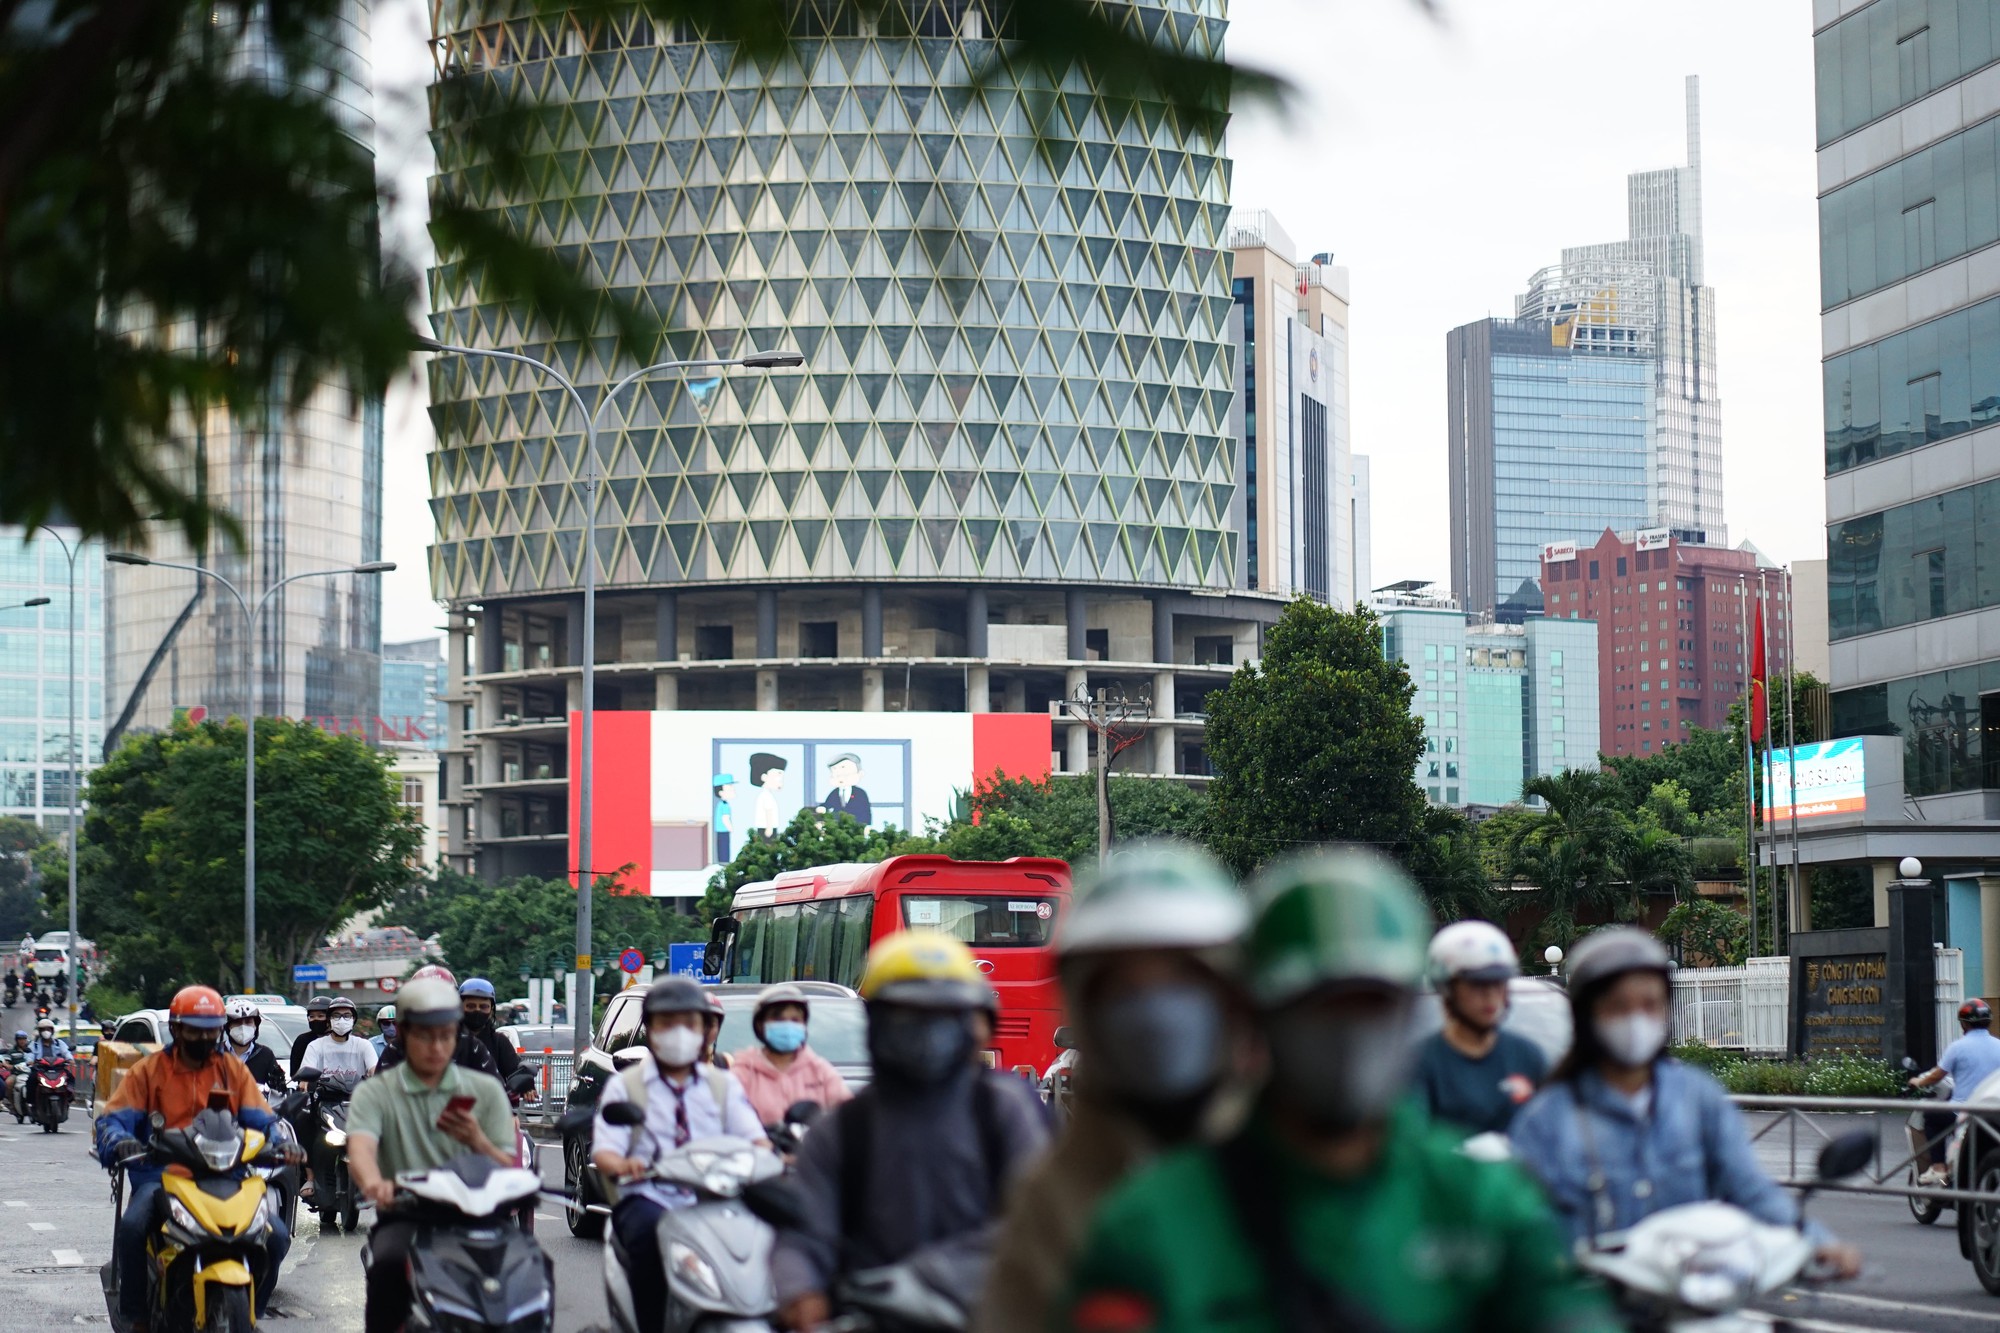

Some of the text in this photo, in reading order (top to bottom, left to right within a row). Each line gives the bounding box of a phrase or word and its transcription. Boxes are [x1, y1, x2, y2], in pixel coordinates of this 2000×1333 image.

[1554, 547, 1574, 555] SABECO
[1038, 906, 1050, 916] 24
[1843, 962, 1854, 980] TY
